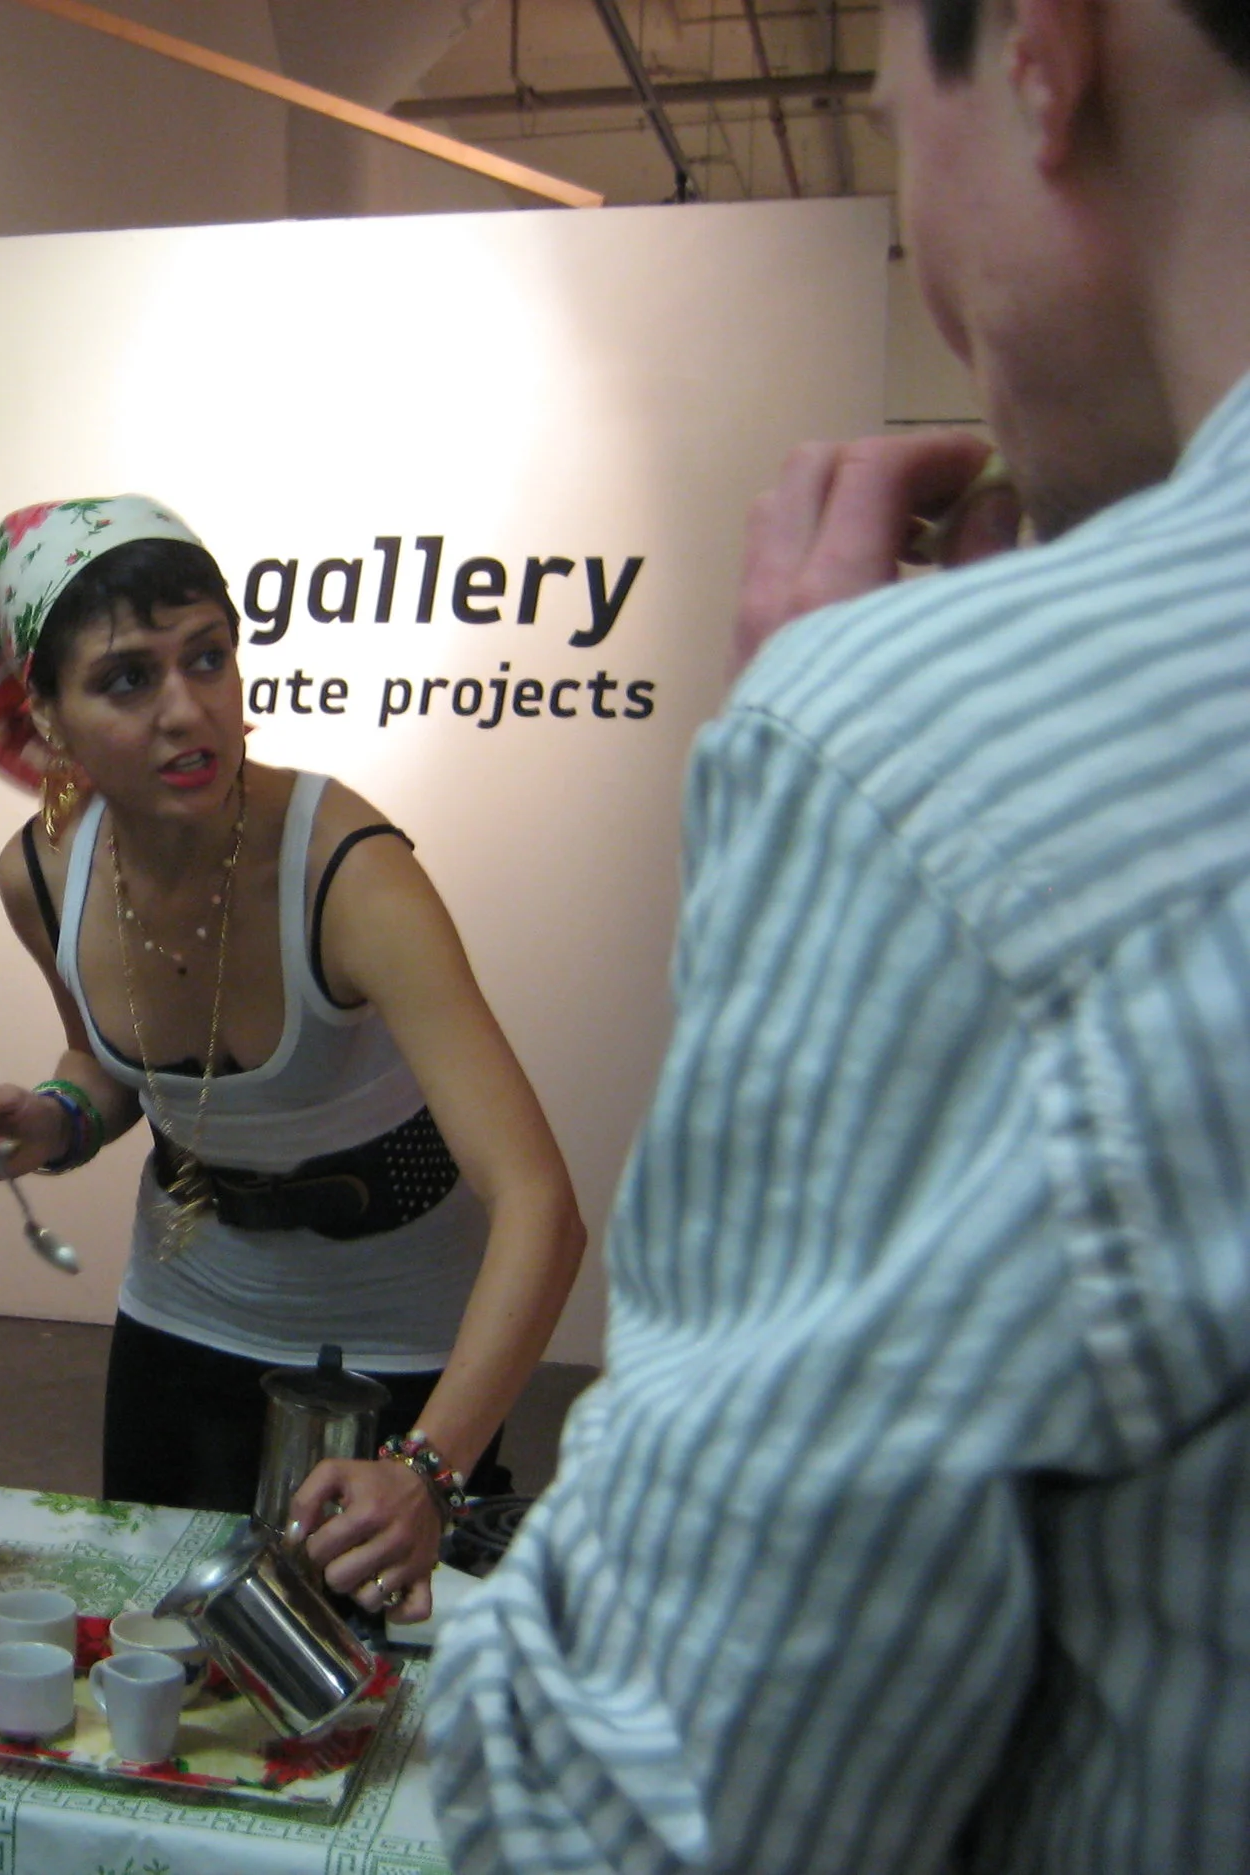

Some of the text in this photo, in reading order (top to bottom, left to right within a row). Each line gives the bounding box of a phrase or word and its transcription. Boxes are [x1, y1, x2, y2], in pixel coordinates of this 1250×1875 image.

[242, 535, 646, 647] gallery
[248, 661, 656, 728] ate projects
